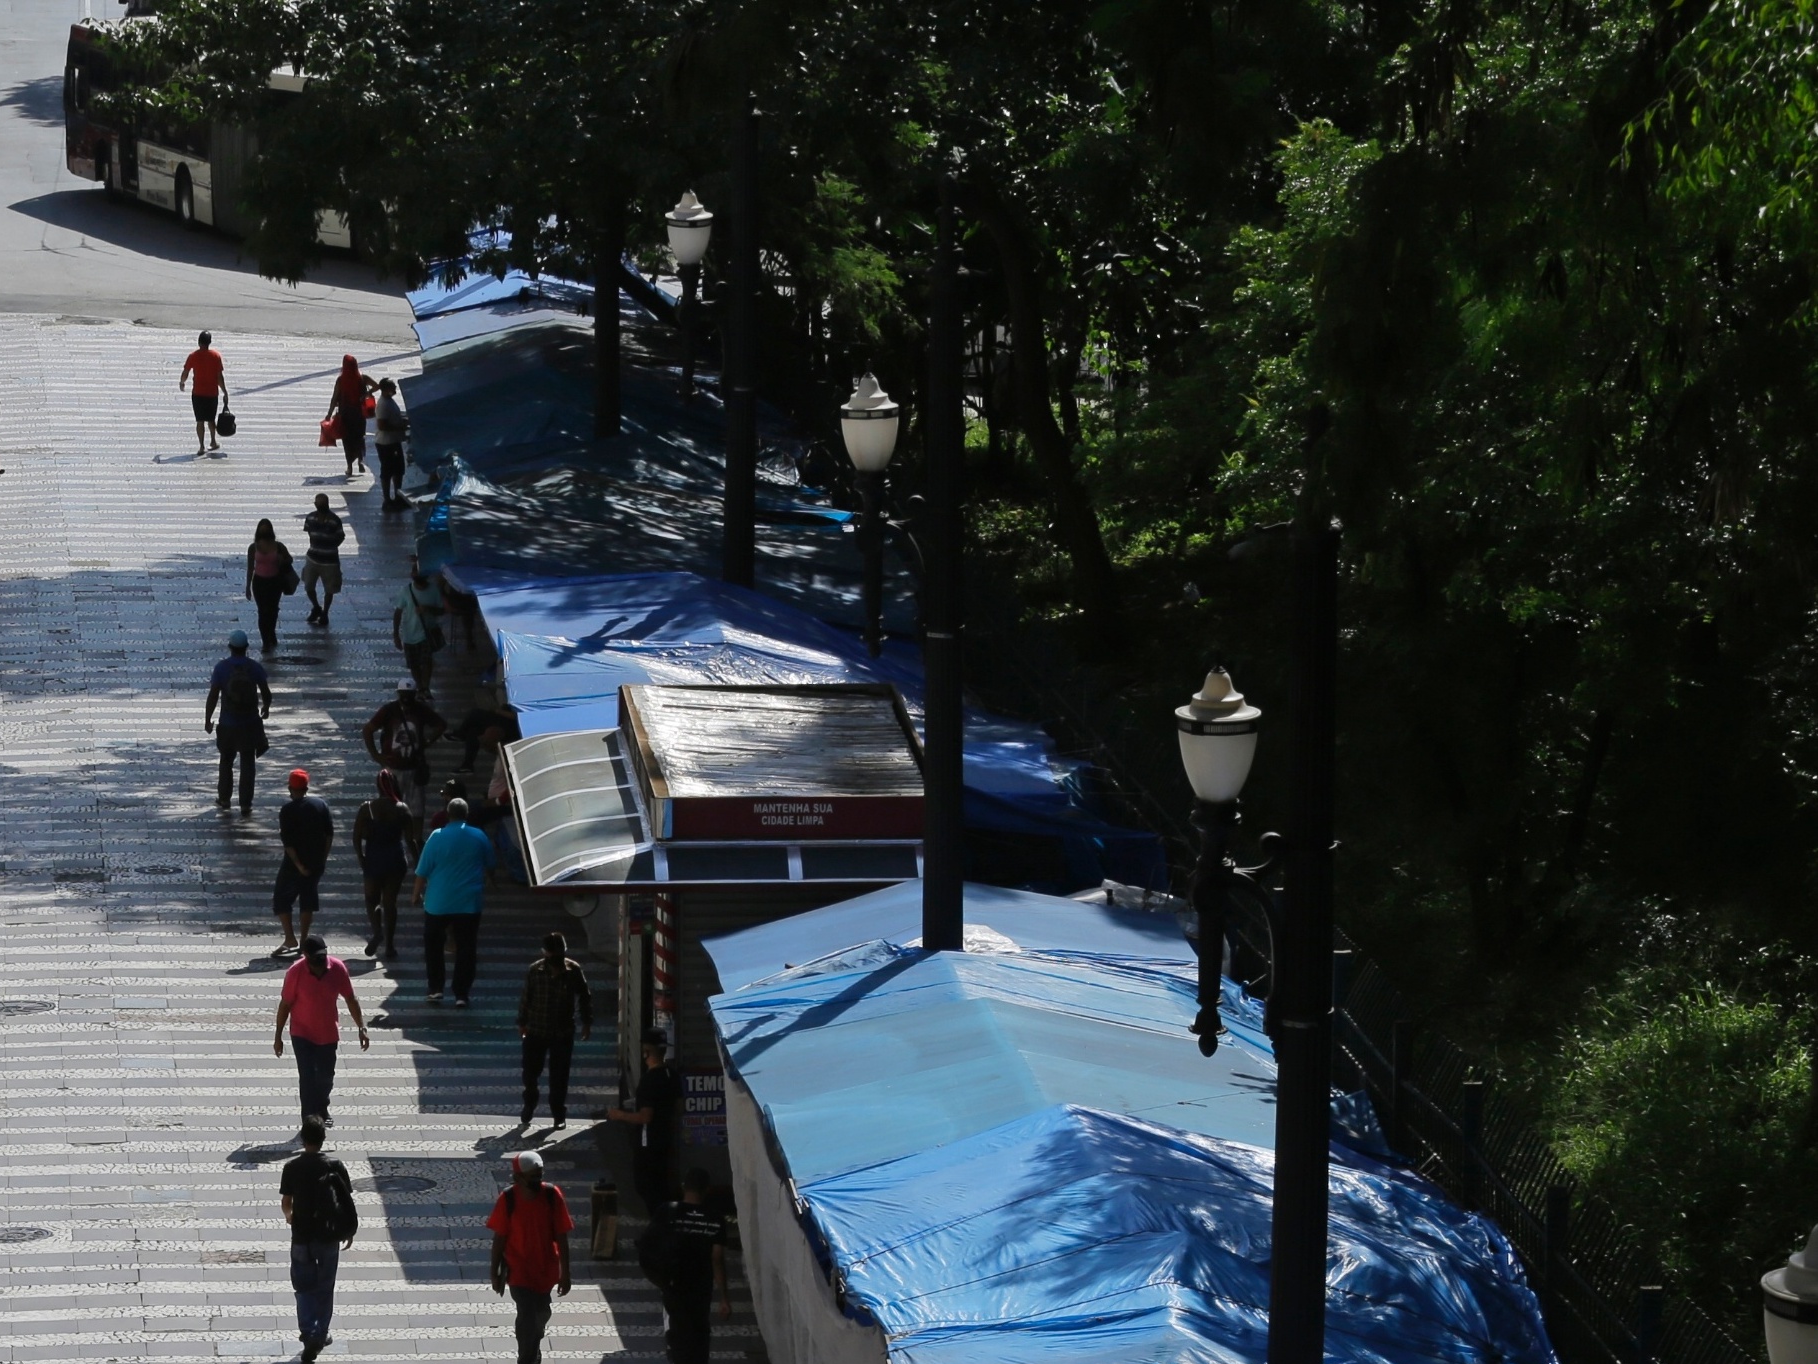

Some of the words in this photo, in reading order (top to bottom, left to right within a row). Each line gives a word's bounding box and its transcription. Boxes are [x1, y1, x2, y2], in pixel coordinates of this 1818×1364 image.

[753, 803, 810, 814] MANTENHA
[813, 803, 834, 814] SUA
[761, 815, 795, 826] CIDADE
[796, 815, 824, 826] LIMPA
[685, 1075, 726, 1092] TEMO
[685, 1097, 723, 1112] CHIP
